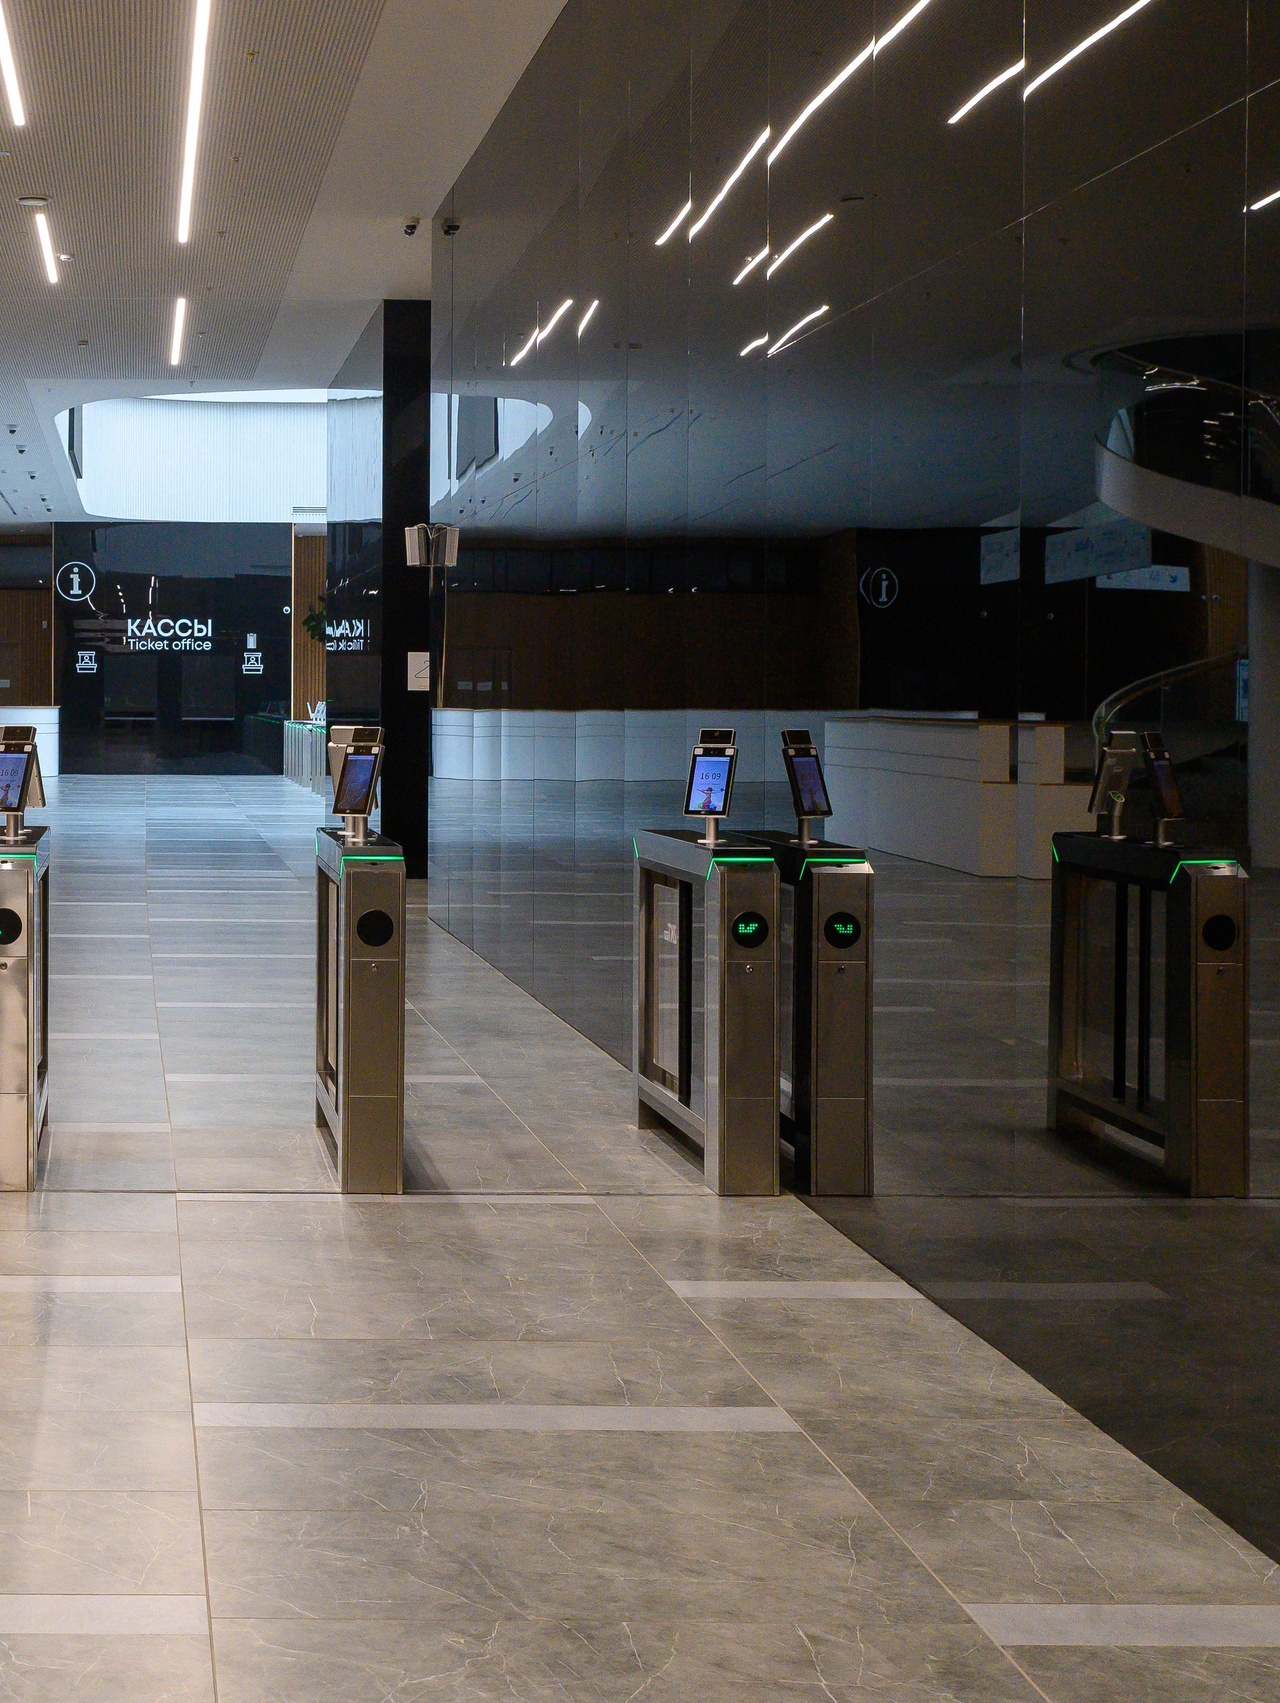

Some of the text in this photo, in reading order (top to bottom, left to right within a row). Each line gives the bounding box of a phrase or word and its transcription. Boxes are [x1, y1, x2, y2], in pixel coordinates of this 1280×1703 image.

[127, 618, 212, 637] КАССЫ
[128, 638, 212, 651] Ticket office
